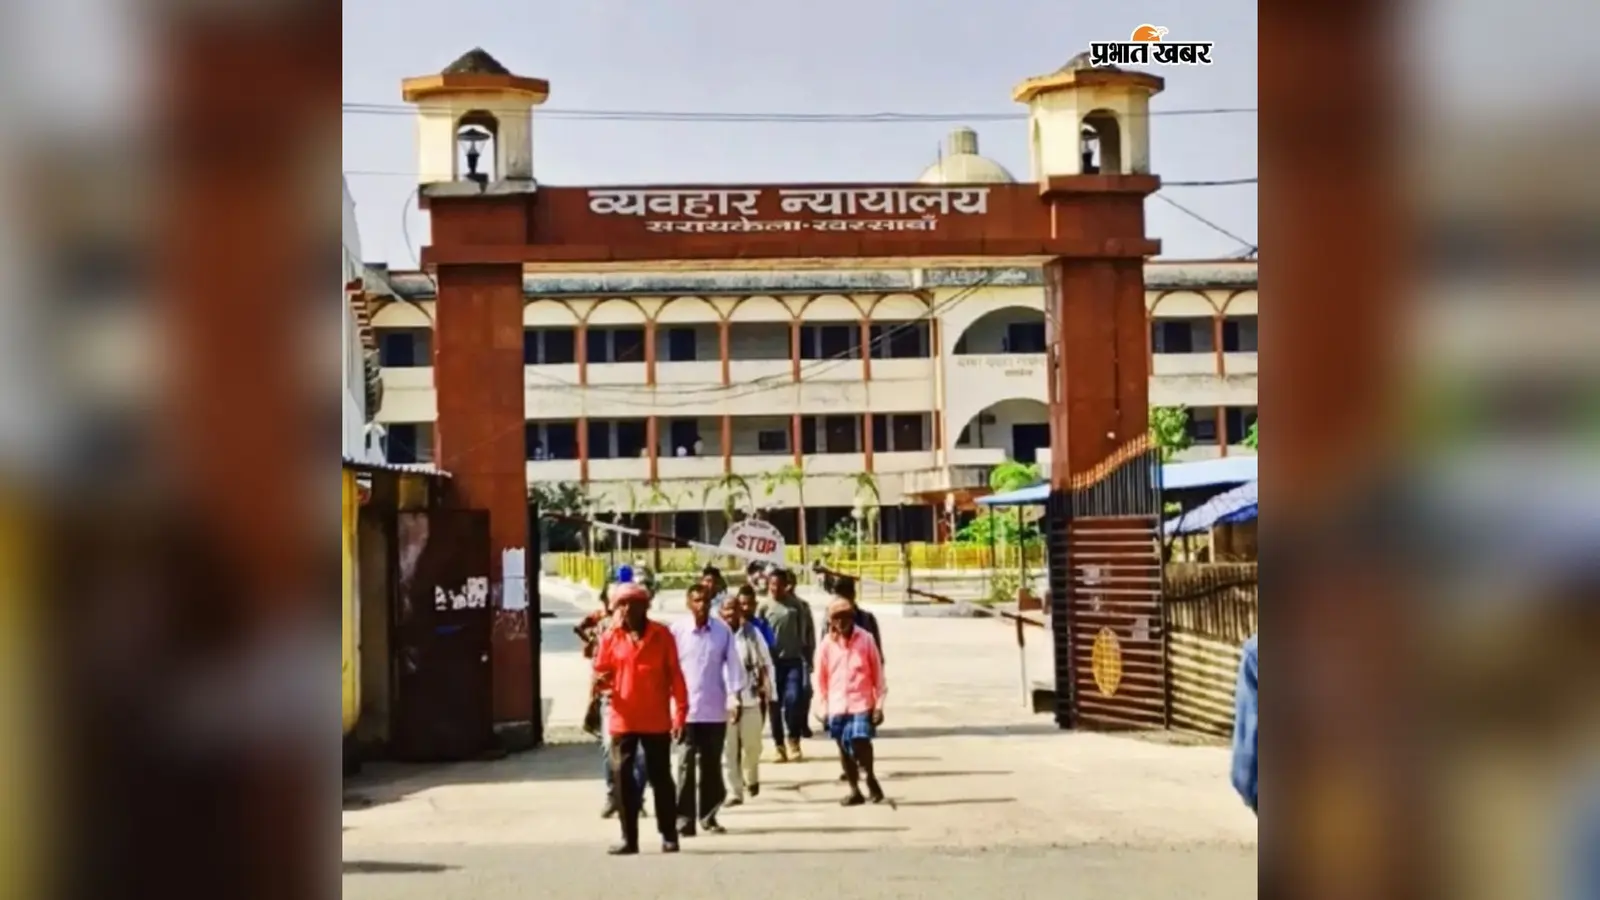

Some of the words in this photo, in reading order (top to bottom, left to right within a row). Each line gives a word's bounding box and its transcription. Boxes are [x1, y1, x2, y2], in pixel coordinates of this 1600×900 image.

[587, 189, 762, 218] व्यवहार
[778, 187, 991, 214] न्यायालय
[736, 534, 777, 555] STOP
